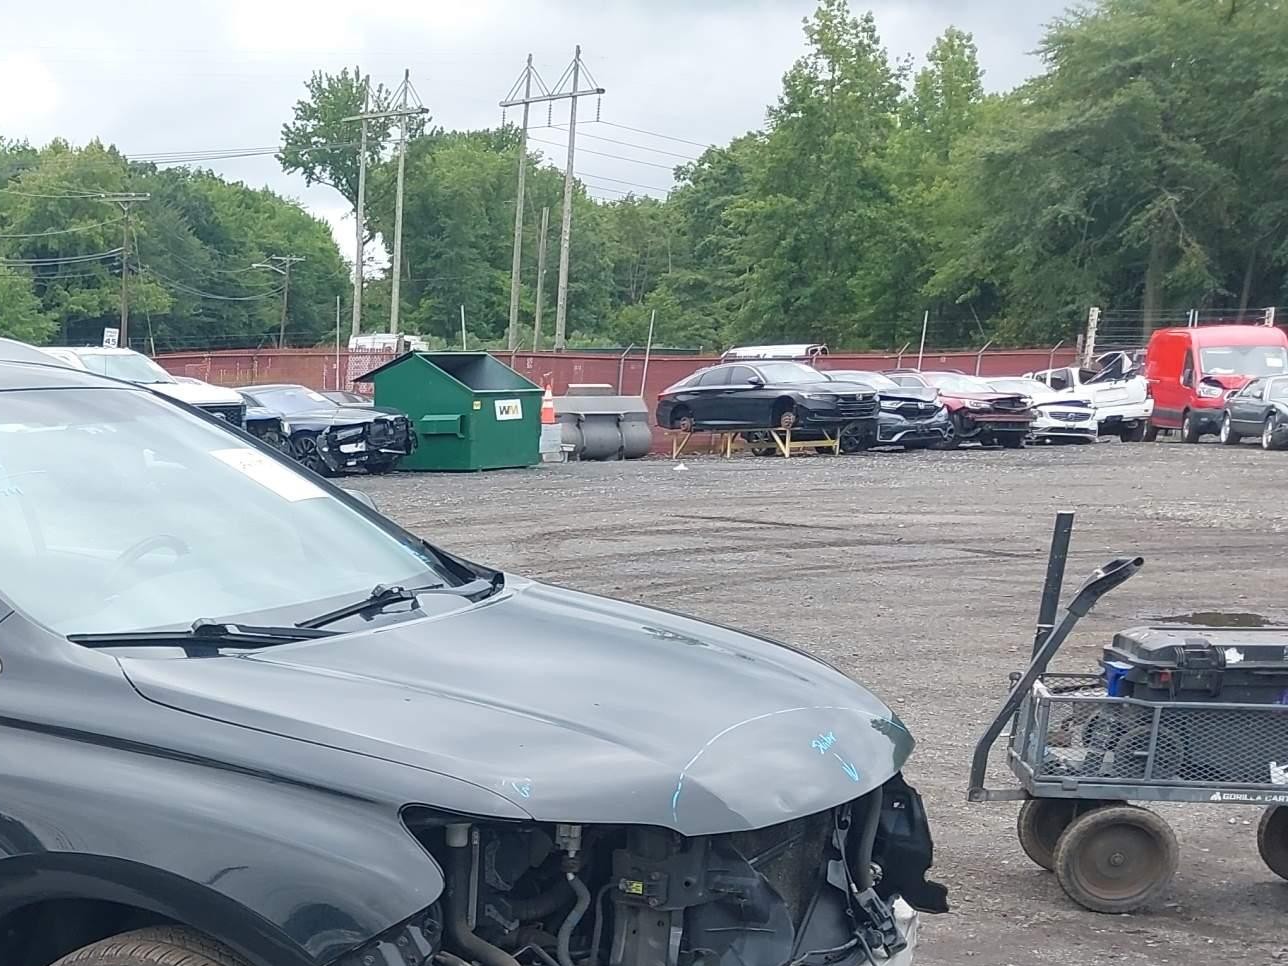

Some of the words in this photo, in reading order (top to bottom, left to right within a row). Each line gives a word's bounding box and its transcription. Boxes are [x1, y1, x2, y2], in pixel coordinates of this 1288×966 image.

[104, 338, 117, 346] 45
[499, 405, 520, 416] WM
[1223, 793, 1262, 801] GORILLA
